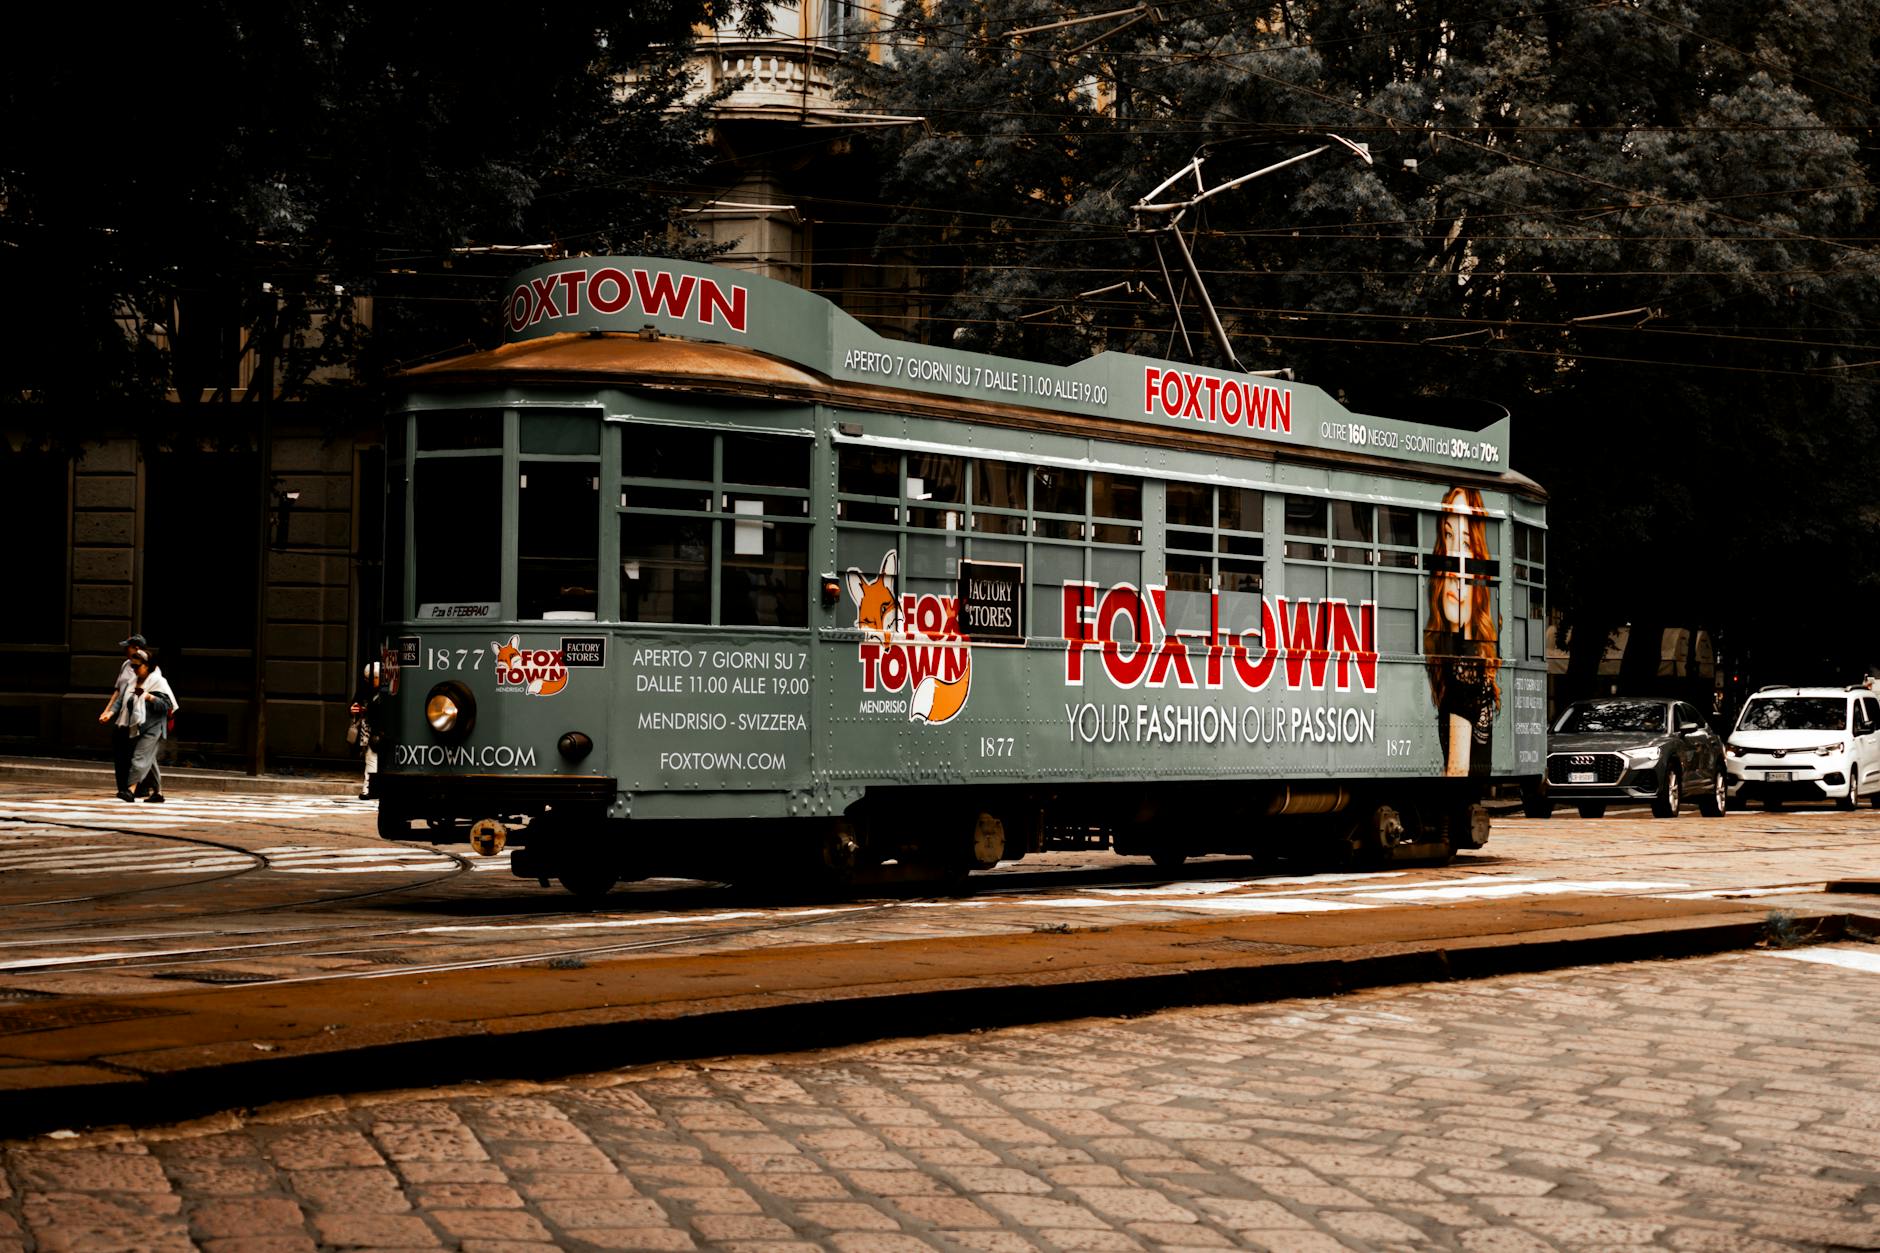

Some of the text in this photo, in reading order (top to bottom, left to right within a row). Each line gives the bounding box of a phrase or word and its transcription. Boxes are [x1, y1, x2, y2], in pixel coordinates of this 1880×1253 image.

[845, 350, 893, 375] APERTO
[896, 356, 904, 376] 7
[907, 358, 952, 383] GIORNI
[955, 364, 971, 386] SU
[975, 367, 982, 387] 7
[985, 369, 1018, 392] DALLE
[1021, 374, 1052, 397] 11.00
[1144, 365, 1293, 434] FOXTOWN
[1321, 422, 1347, 441] OLTRE
[1348, 423, 1367, 445] 160
[1368, 428, 1399, 449] NEGOZI
[1405, 434, 1436, 455] SCONTI
[1436, 438, 1450, 456] dal
[1450, 438, 1471, 459] 30%
[1471, 444, 1479, 459] al
[1480, 442, 1499, 462] 70%
[901, 593, 969, 641] FOX
[1062, 579, 1380, 693] FOXTOWN
[566, 652, 600, 662] STORES
[567, 643, 601, 652] FACTORY
[428, 648, 485, 671] 1877
[520, 650, 568, 667] FOX
[633, 649, 807, 670] APERTO 7 GIORNI SU 7
[859, 643, 971, 693] TOWN
[495, 667, 567, 685] TOWN
[636, 675, 809, 695] DALLE 11.00 ALLE 19.00
[859, 700, 907, 714] MENDRISIO
[638, 713, 727, 730] MENDRISIO
[738, 713, 807, 731] SVIZZERA
[1065, 703, 1375, 745] YOUR FASHION OUR PASSION
[980, 737, 1014, 757] 1877
[1387, 739, 1412, 757] 1877
[661, 753, 786, 770] FOXTOWN.COM
